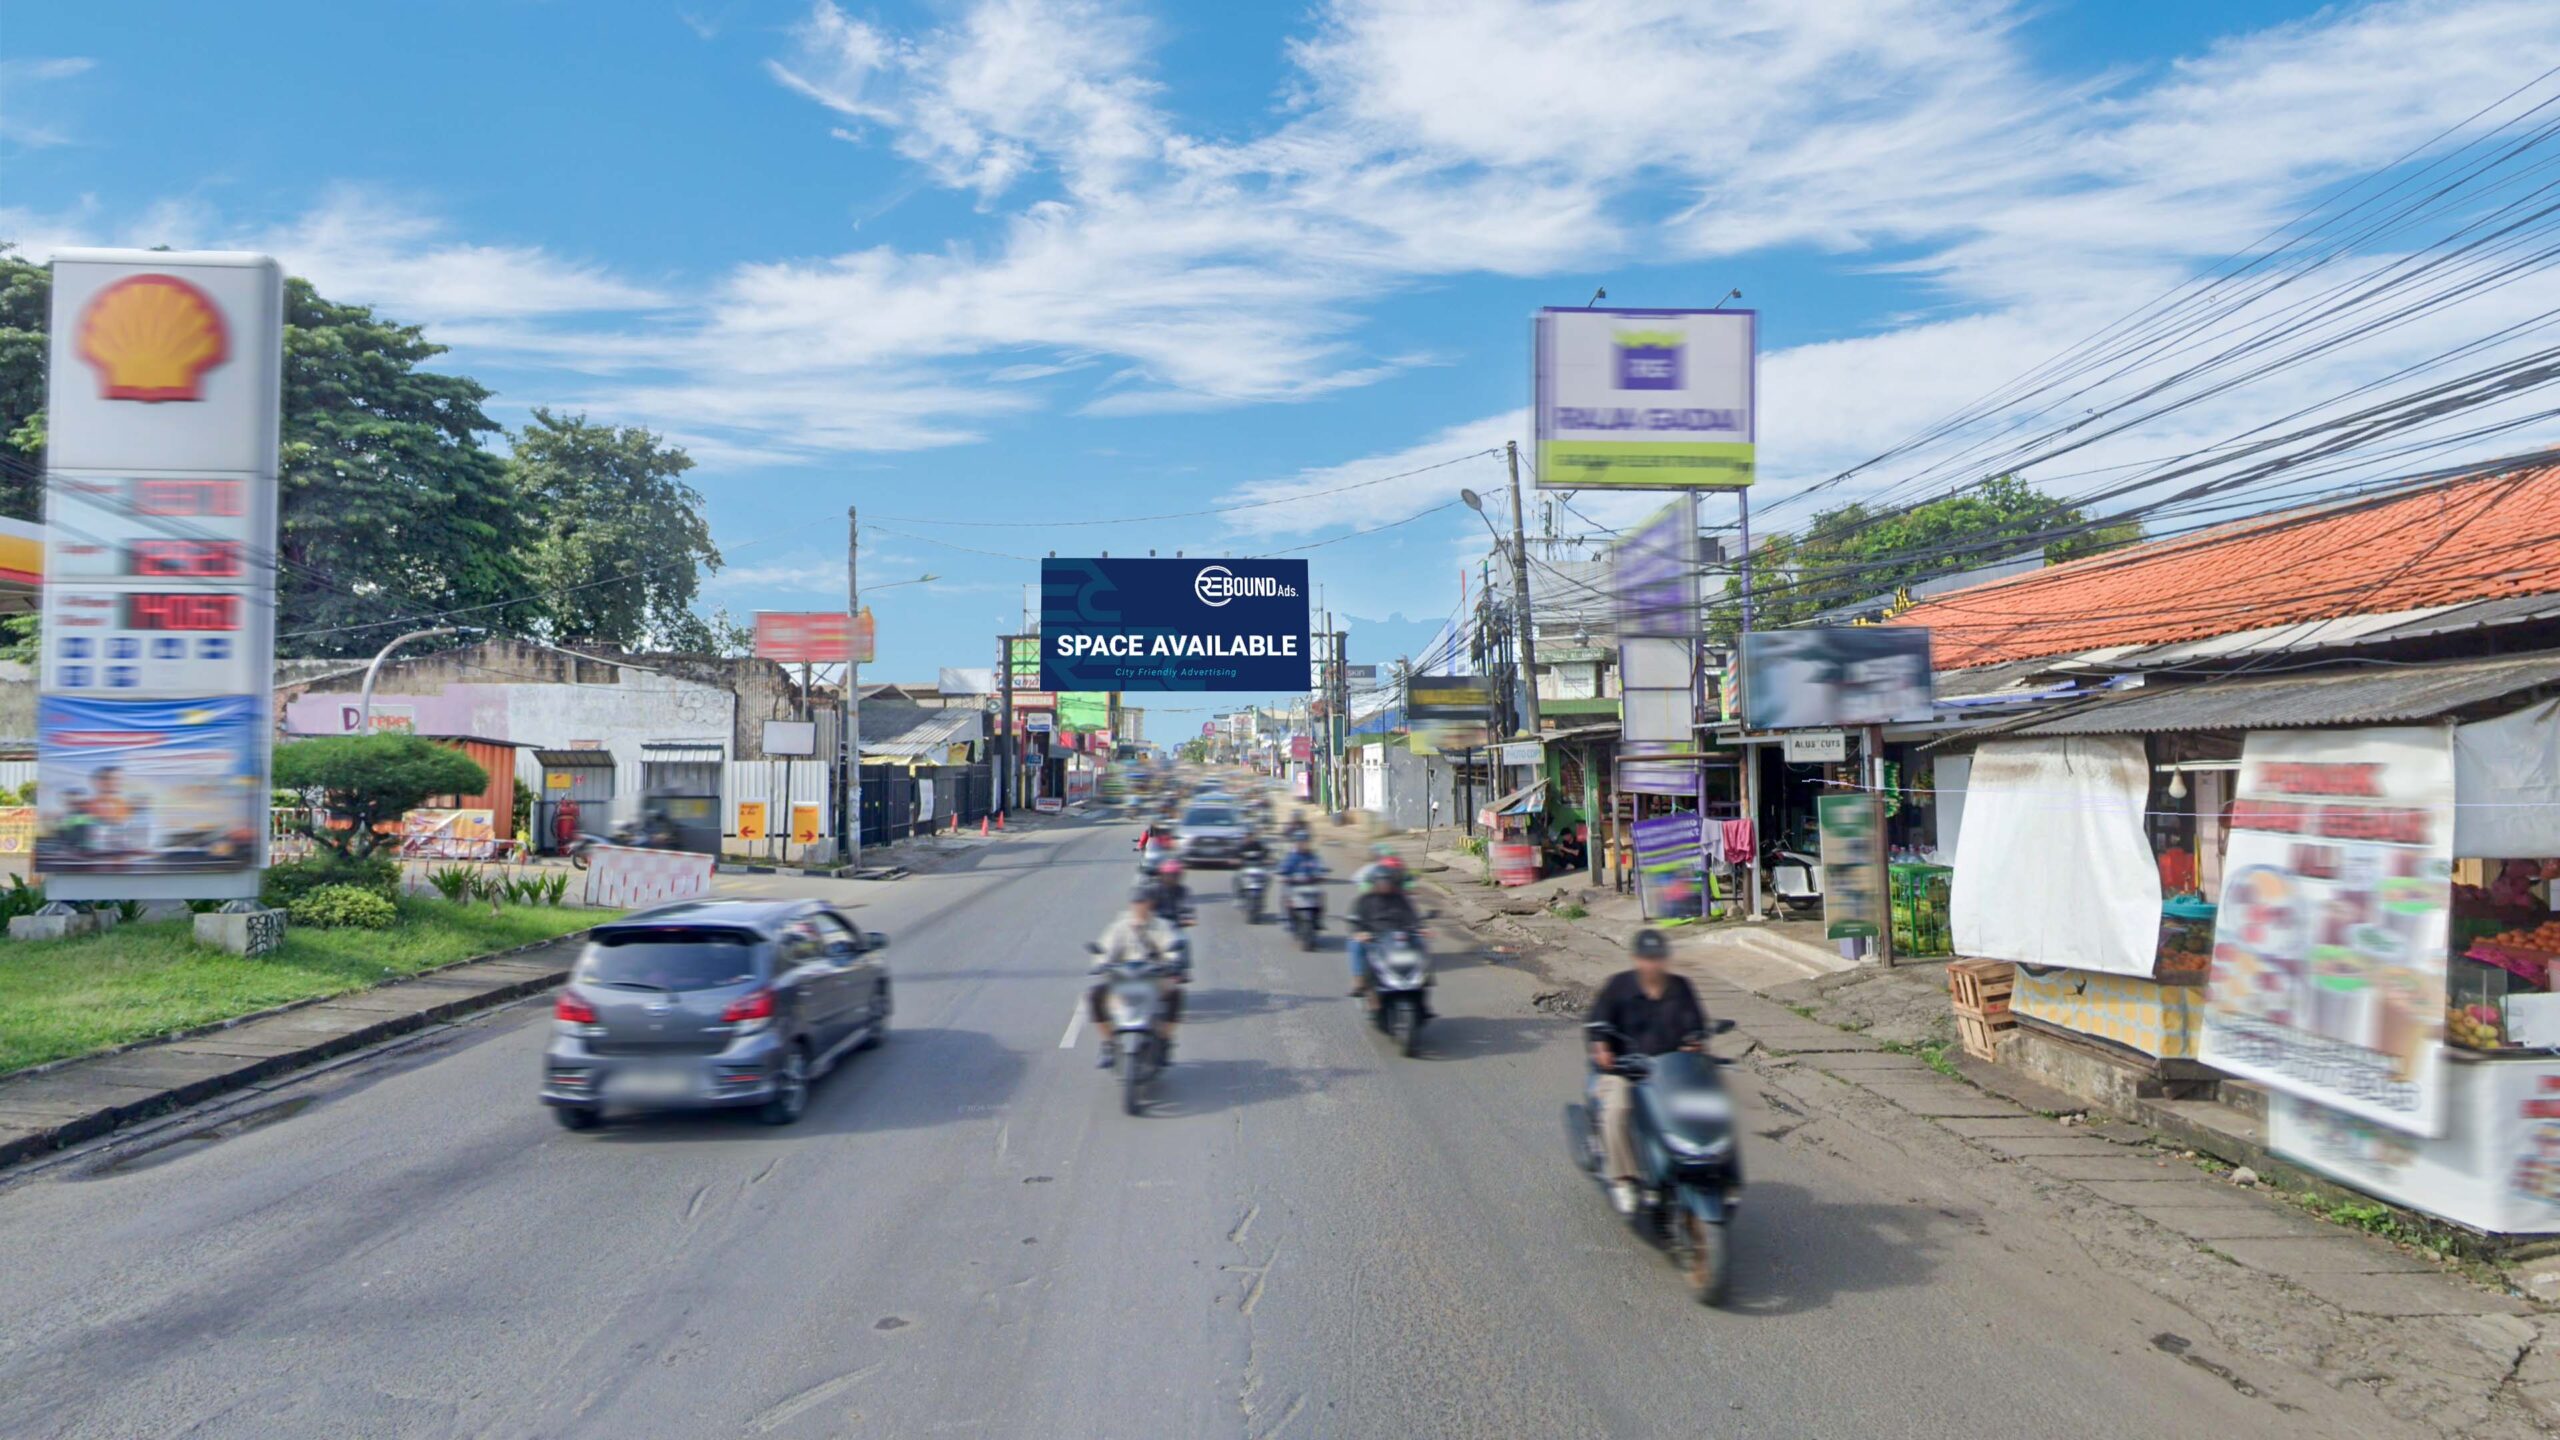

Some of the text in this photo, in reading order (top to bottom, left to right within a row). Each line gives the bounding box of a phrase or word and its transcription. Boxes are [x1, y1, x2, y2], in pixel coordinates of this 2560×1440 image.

[1197, 576, 1299, 597] REBOUND Ads.
[1057, 635, 1298, 656] SPACE AVAILABLE
[1115, 667, 1237, 678] City Friendly Advertising
